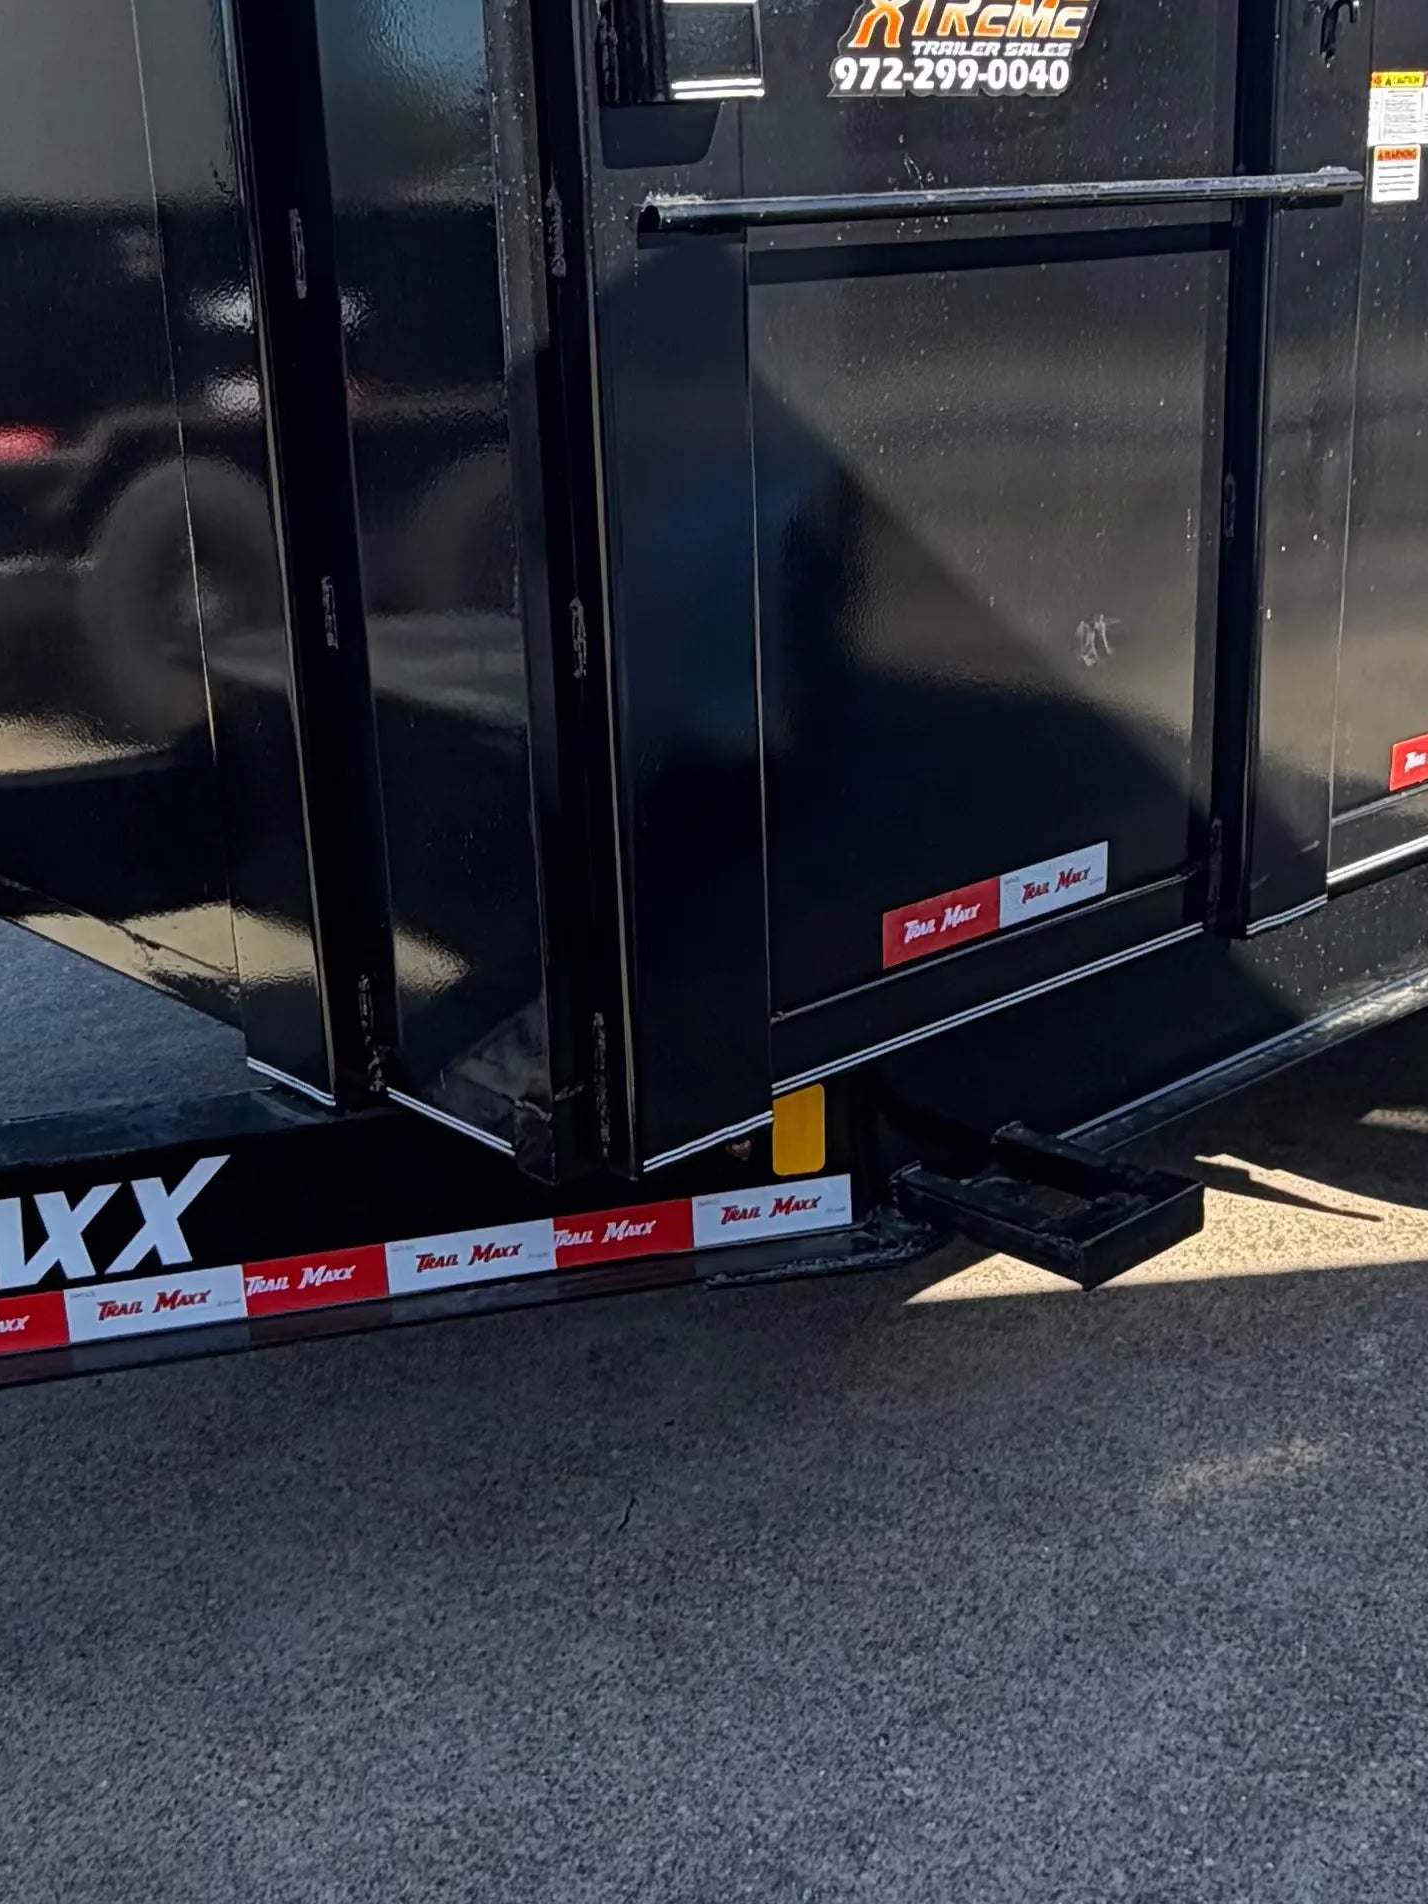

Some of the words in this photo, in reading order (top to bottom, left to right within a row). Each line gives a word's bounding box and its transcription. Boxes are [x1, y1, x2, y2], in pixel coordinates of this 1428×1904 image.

[912, 40, 1000, 56] TRAILER
[1004, 41, 1072, 57] SALES
[834, 57, 1070, 91] 972-299-0040
[904, 919, 935, 944] TRAIL
[940, 903, 981, 933] MAXX
[721, 1205, 761, 1225] TRAIL
[769, 1195, 822, 1218] MAXX
[553, 1229, 593, 1249] TRAIL
[601, 1219, 657, 1244] MAXX
[415, 1252, 459, 1273] TRAIL
[467, 1242, 524, 1266] MAXX
[244, 1275, 290, 1296] TRAIL
[297, 1264, 357, 1290] MAXX
[97, 1300, 143, 1321] TRAIL
[152, 1289, 212, 1314] MAXX
